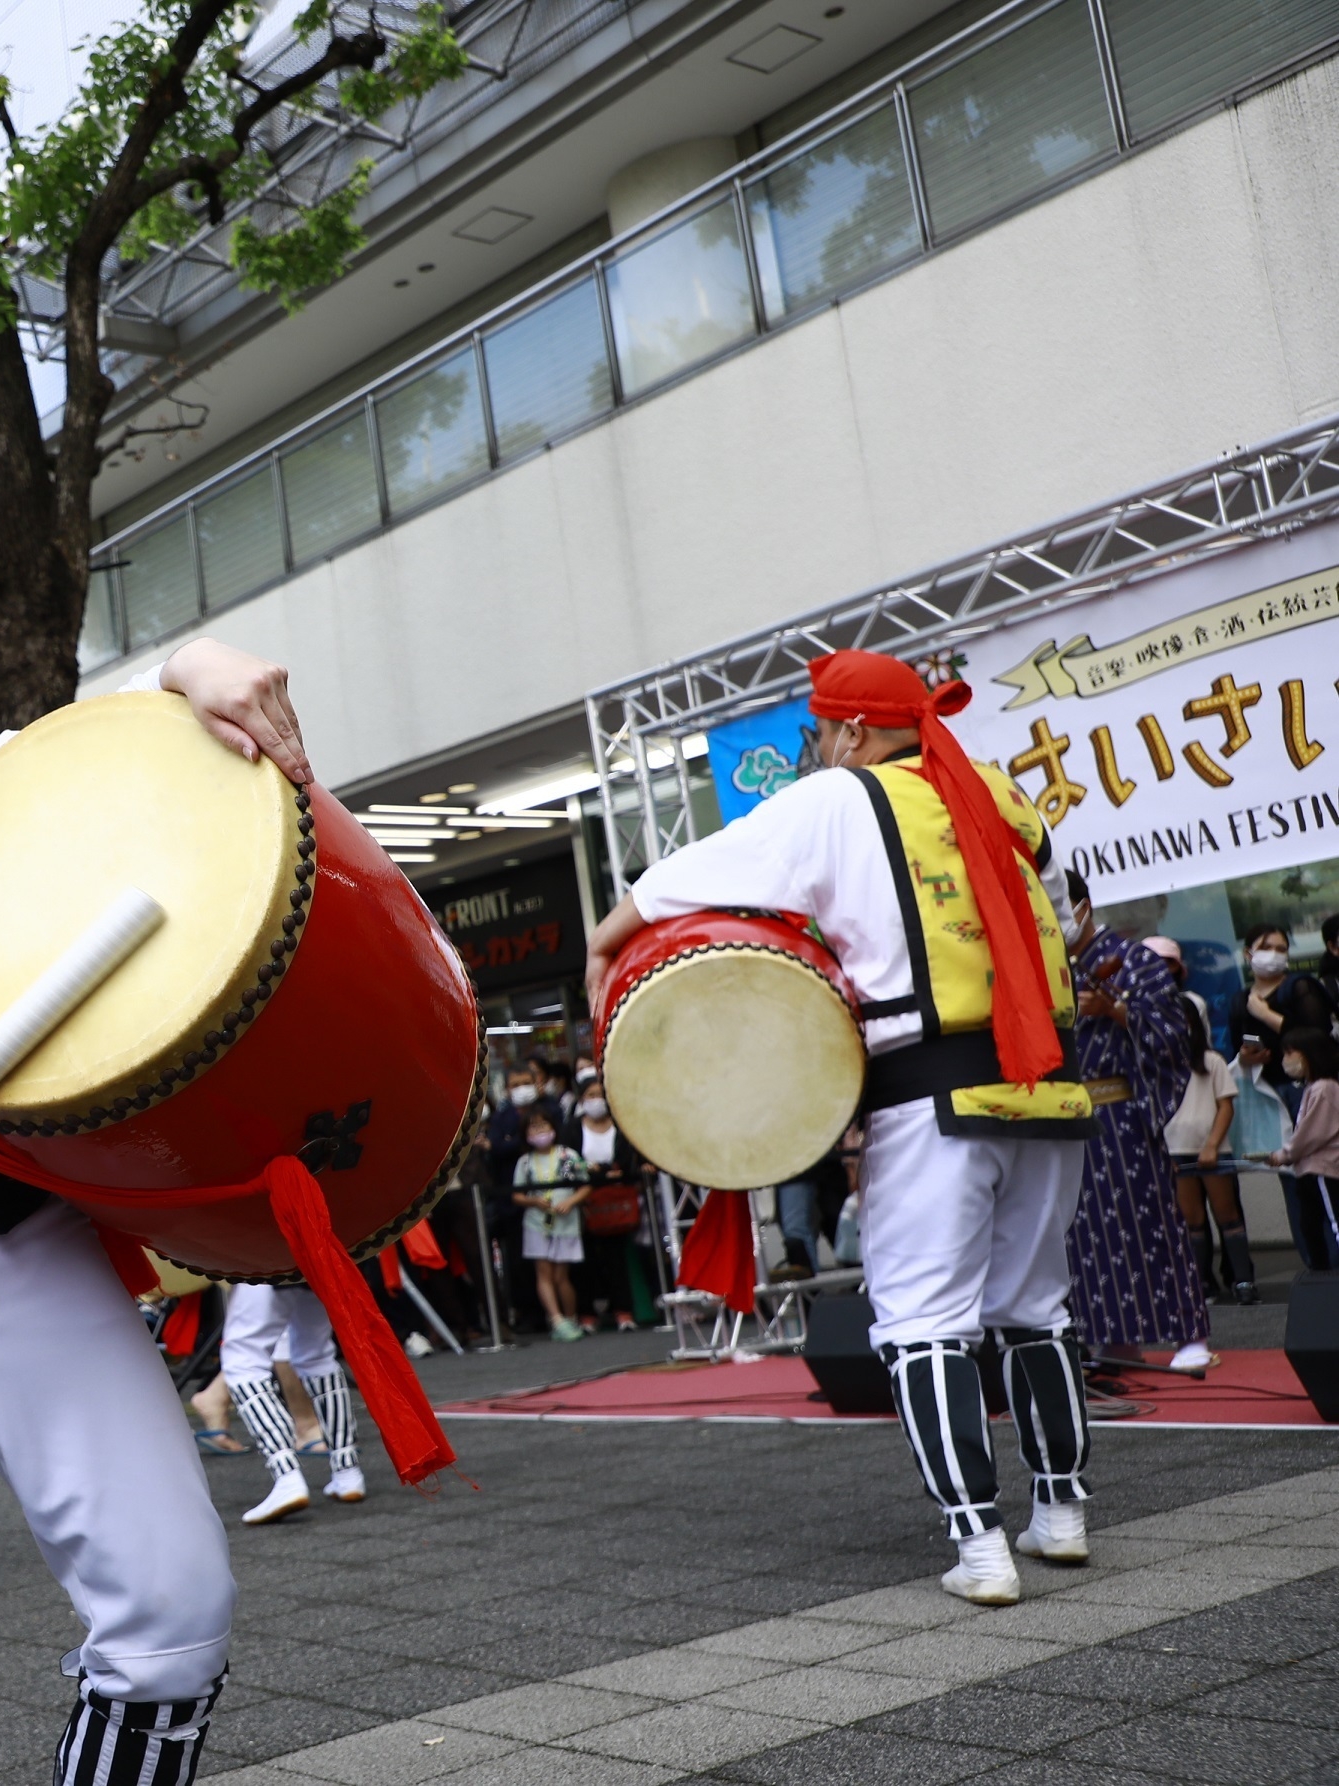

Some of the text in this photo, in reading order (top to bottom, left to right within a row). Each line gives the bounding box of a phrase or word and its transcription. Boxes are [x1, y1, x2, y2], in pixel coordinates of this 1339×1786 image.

[992, 673, 1339, 830] はいさい
[1071, 820, 1220, 879] OKINAWA
[445, 887, 510, 932] FRONT
